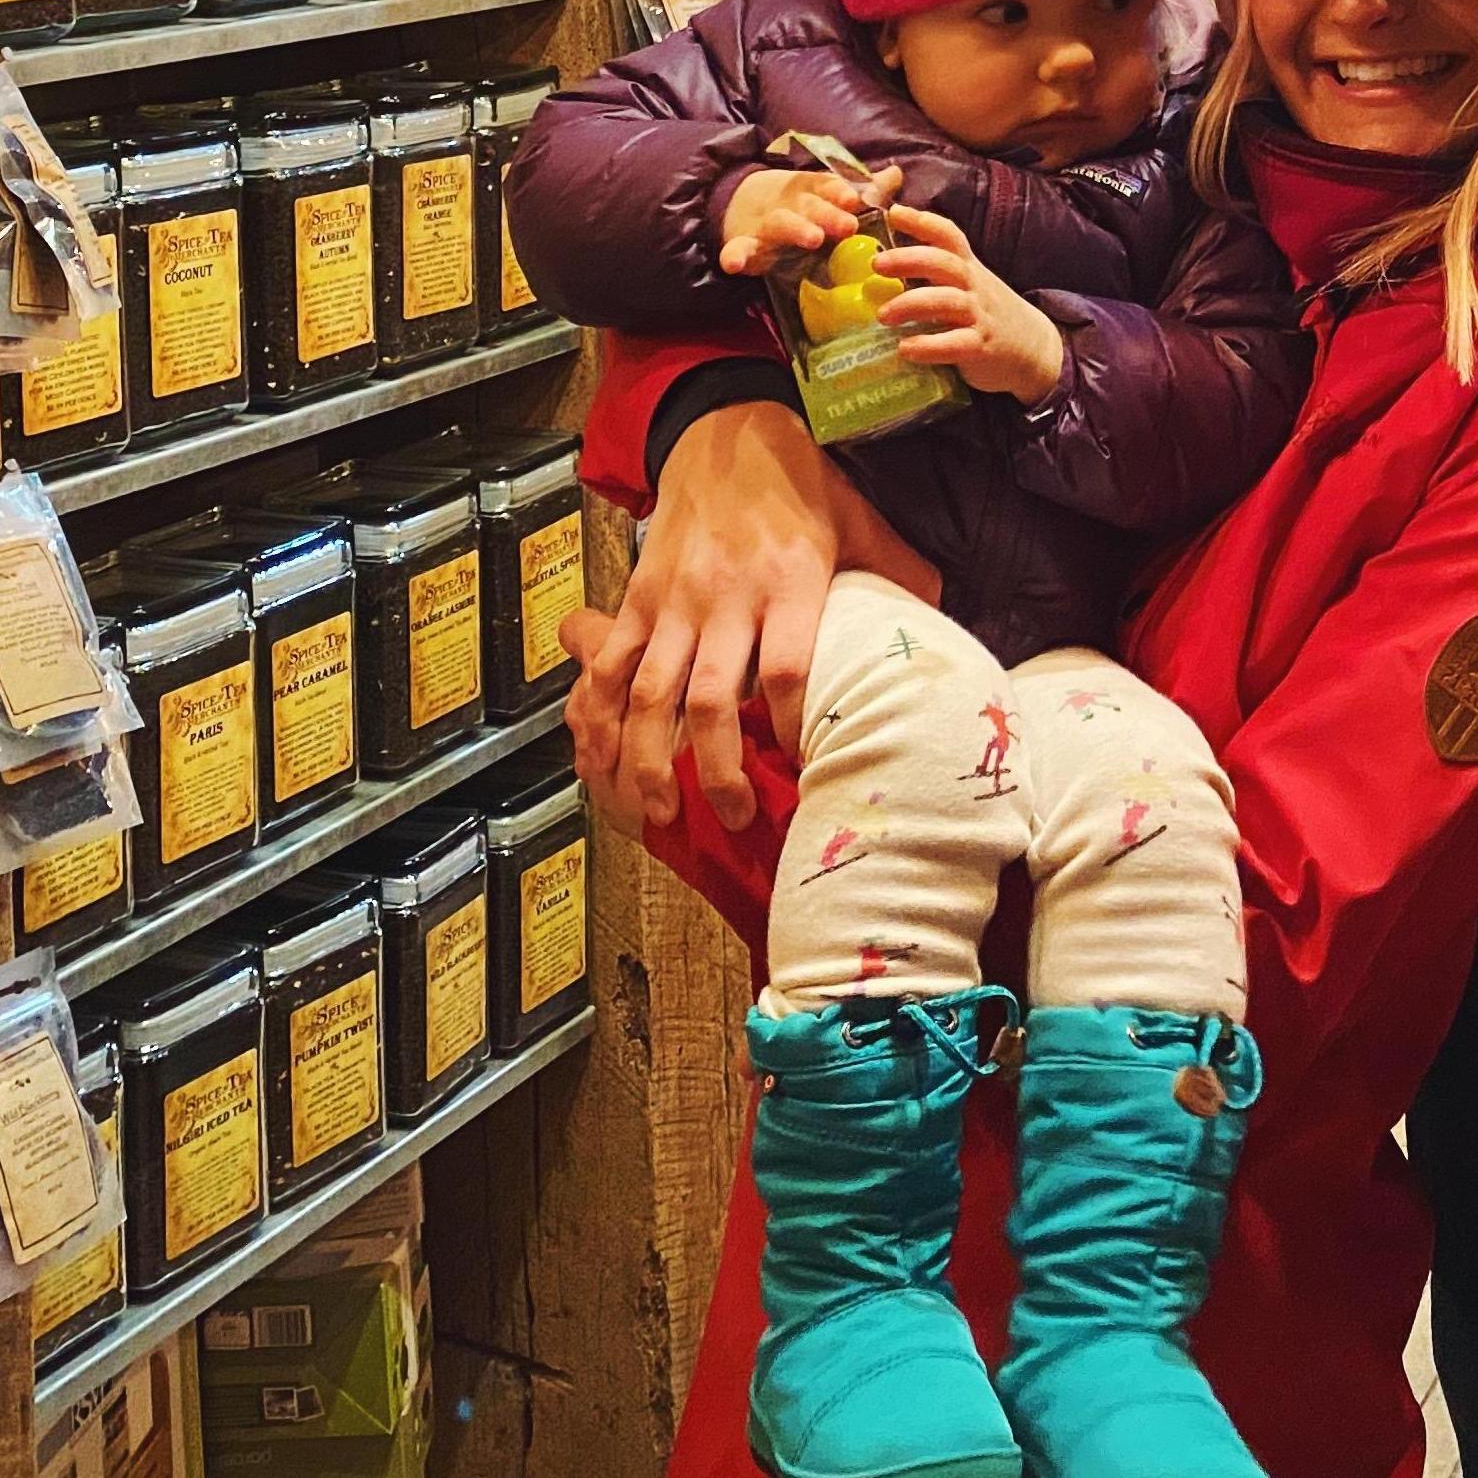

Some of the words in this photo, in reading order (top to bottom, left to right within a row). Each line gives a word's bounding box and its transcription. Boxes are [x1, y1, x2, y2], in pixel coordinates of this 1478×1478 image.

[421, 170, 457, 190] SPICE
[311, 208, 341, 226] SPICE
[168, 234, 204, 254] SPICE
[208, 227, 233, 245] TEA
[164, 263, 213, 285] COCONUT
[288, 643, 322, 667] SPICE
[324, 631, 348, 649] TEA
[272, 680, 300, 702] PEAR
[301, 659, 348, 689] CARAMEL
[180, 695, 217, 719] SPICE
[221, 681, 248, 701] TEA
[190, 721, 224, 746] PARIS
[314, 996, 362, 1025] SPICE
[294, 1030, 342, 1068] PUMPKIN
[343, 1013, 375, 1042] TWIST
[185, 1086, 222, 1115] SPICE
[206, 1110, 231, 1133] ICED
[232, 1096, 253, 1118] TEA
